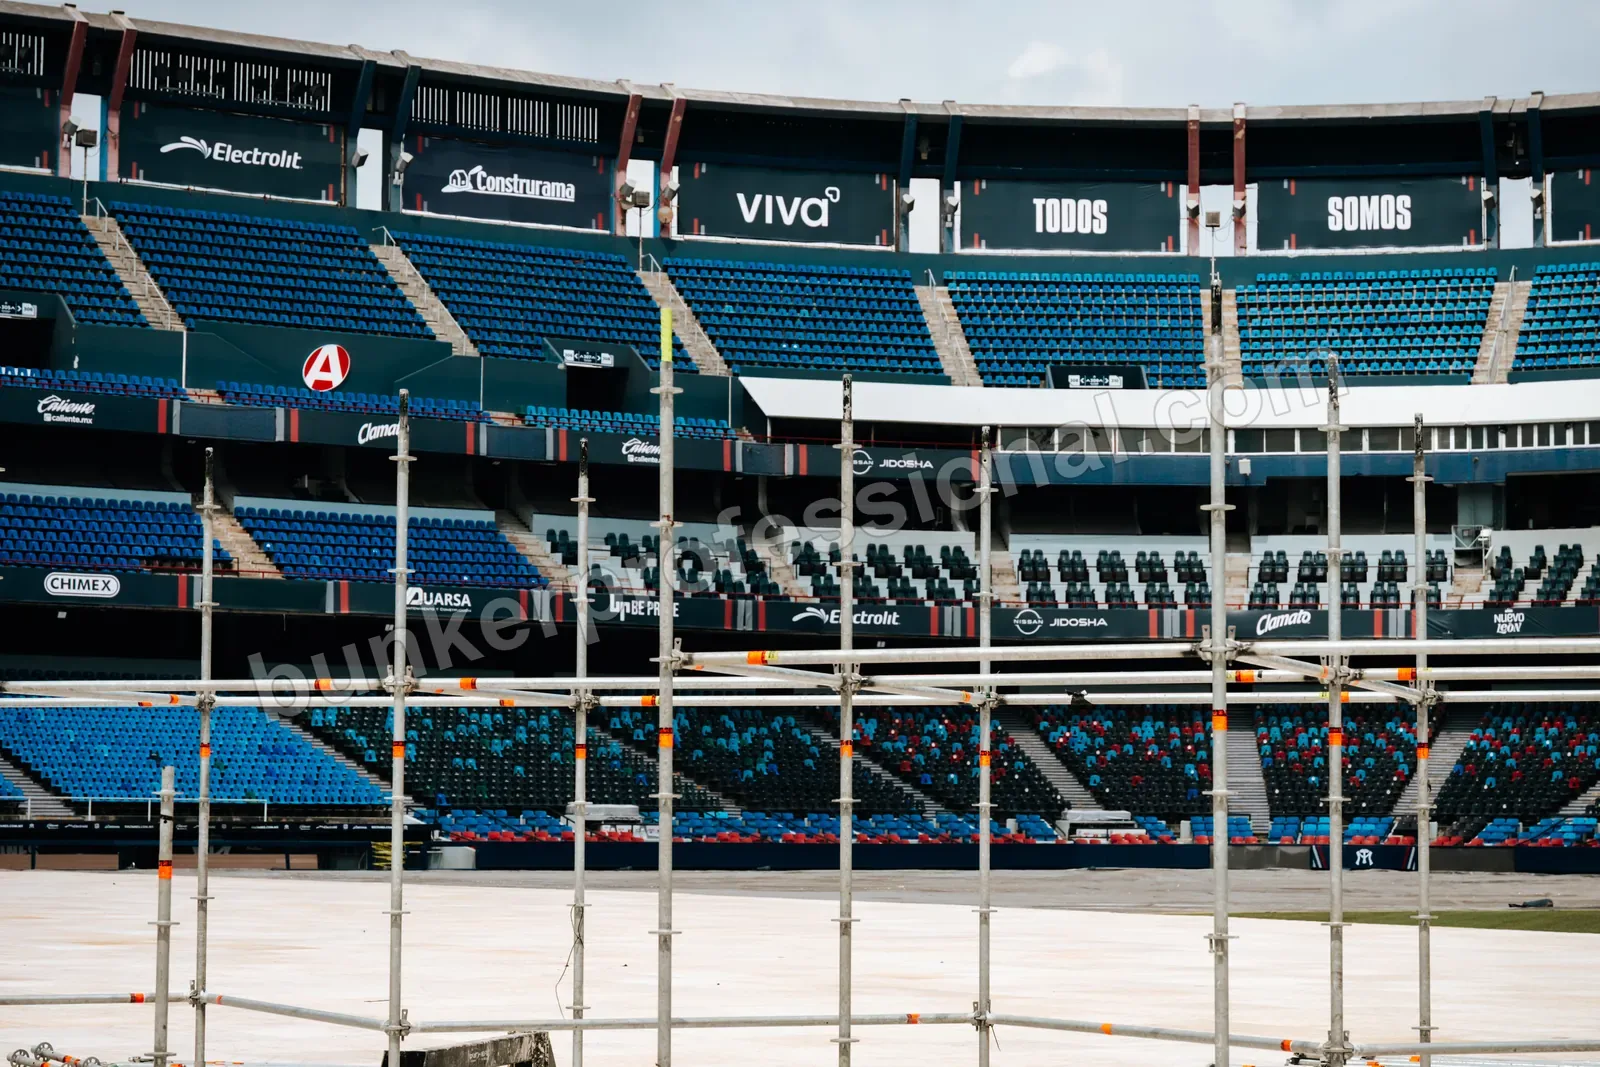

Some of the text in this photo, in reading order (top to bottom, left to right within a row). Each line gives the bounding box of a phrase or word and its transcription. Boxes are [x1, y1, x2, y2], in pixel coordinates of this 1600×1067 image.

[212, 142, 303, 169] Electrolit
[476, 170, 575, 199] Construrama
[1032, 198, 1108, 234] TODOS
[1327, 194, 1412, 231] SOMOS
[37, 394, 96, 415] Caliente
[51, 414, 93, 424] caliente.mx
[621, 437, 661, 455] Calien
[879, 459, 934, 469] JIDOSHA
[50, 577, 111, 592] CHIMEX
[631, 600, 645, 616] BE
[647, 601, 680, 618] PRE
[829, 609, 901, 626] Ectrolit
[1049, 618, 1108, 627] JIDOSHA
[1256, 609, 1312, 636] Clamato
